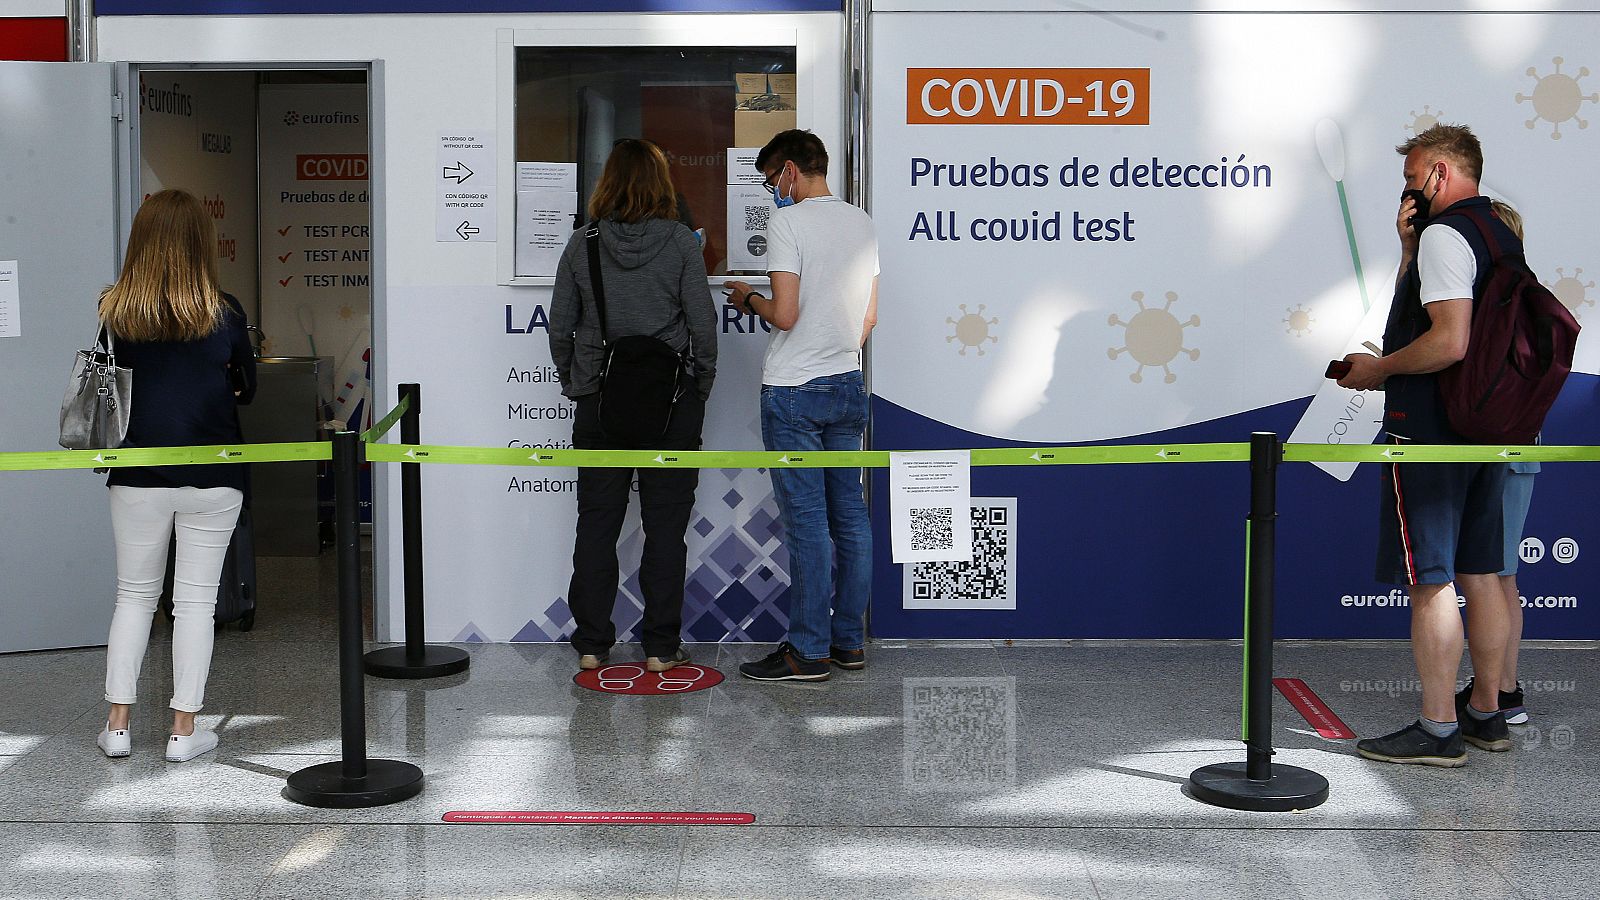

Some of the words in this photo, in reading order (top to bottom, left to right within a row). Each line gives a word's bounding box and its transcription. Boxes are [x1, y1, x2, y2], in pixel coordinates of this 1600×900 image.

[148, 83, 192, 117] eurofins
[921, 79, 1136, 117] COVID-19
[302, 111, 360, 124] eurofins
[202, 132, 232, 154] MEGALAB
[303, 159, 368, 177] COVID
[910, 156, 1049, 188] Pruebas
[1059, 156, 1099, 188] de
[1109, 153, 1272, 188] detección
[281, 190, 336, 203] Pruebas
[339, 190, 355, 203] de
[304, 225, 338, 237] TEST
[341, 225, 369, 237] PCR
[909, 210, 960, 241] All
[970, 210, 1061, 241] covid
[1072, 210, 1136, 241] test
[304, 249, 338, 262] TEST
[341, 249, 369, 262] ANT
[304, 275, 339, 287] TEST
[342, 275, 369, 287] INM
[507, 366, 560, 382] Anális
[508, 403, 576, 419] Microbi
[508, 477, 578, 492] Anatom
